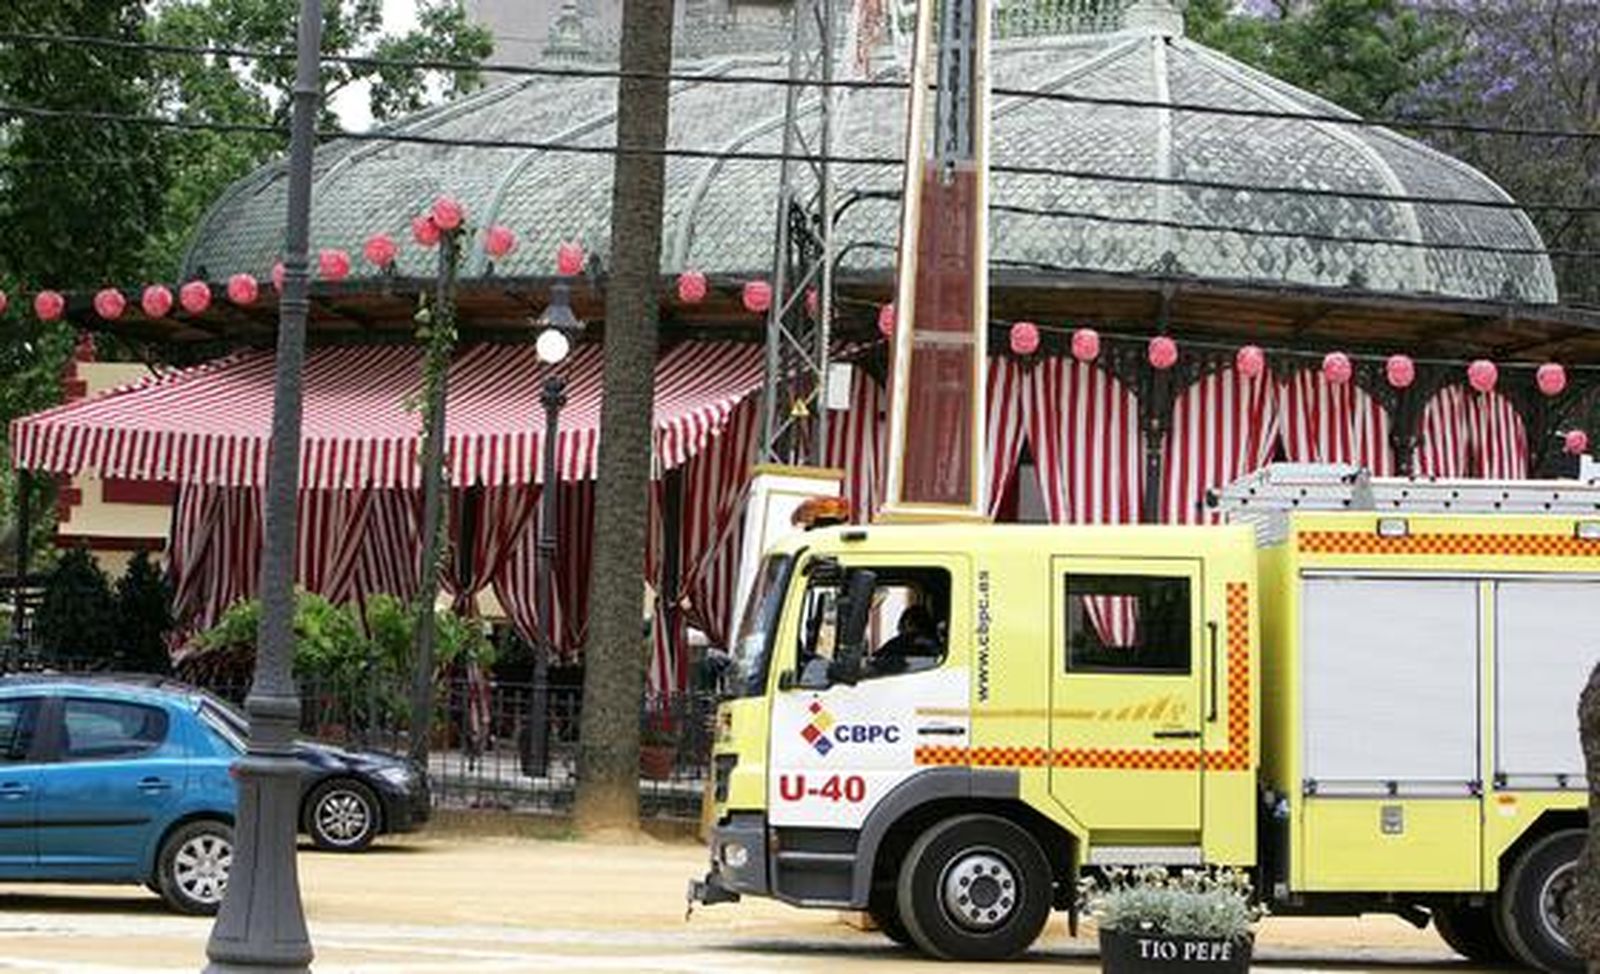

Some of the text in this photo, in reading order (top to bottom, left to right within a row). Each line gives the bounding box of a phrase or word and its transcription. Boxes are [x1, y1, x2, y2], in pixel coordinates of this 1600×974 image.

[978, 570, 991, 702] www.cbpc.es
[834, 724, 901, 743] CBPC
[779, 774, 866, 803] U-40
[1139, 939, 1178, 959] TIO
